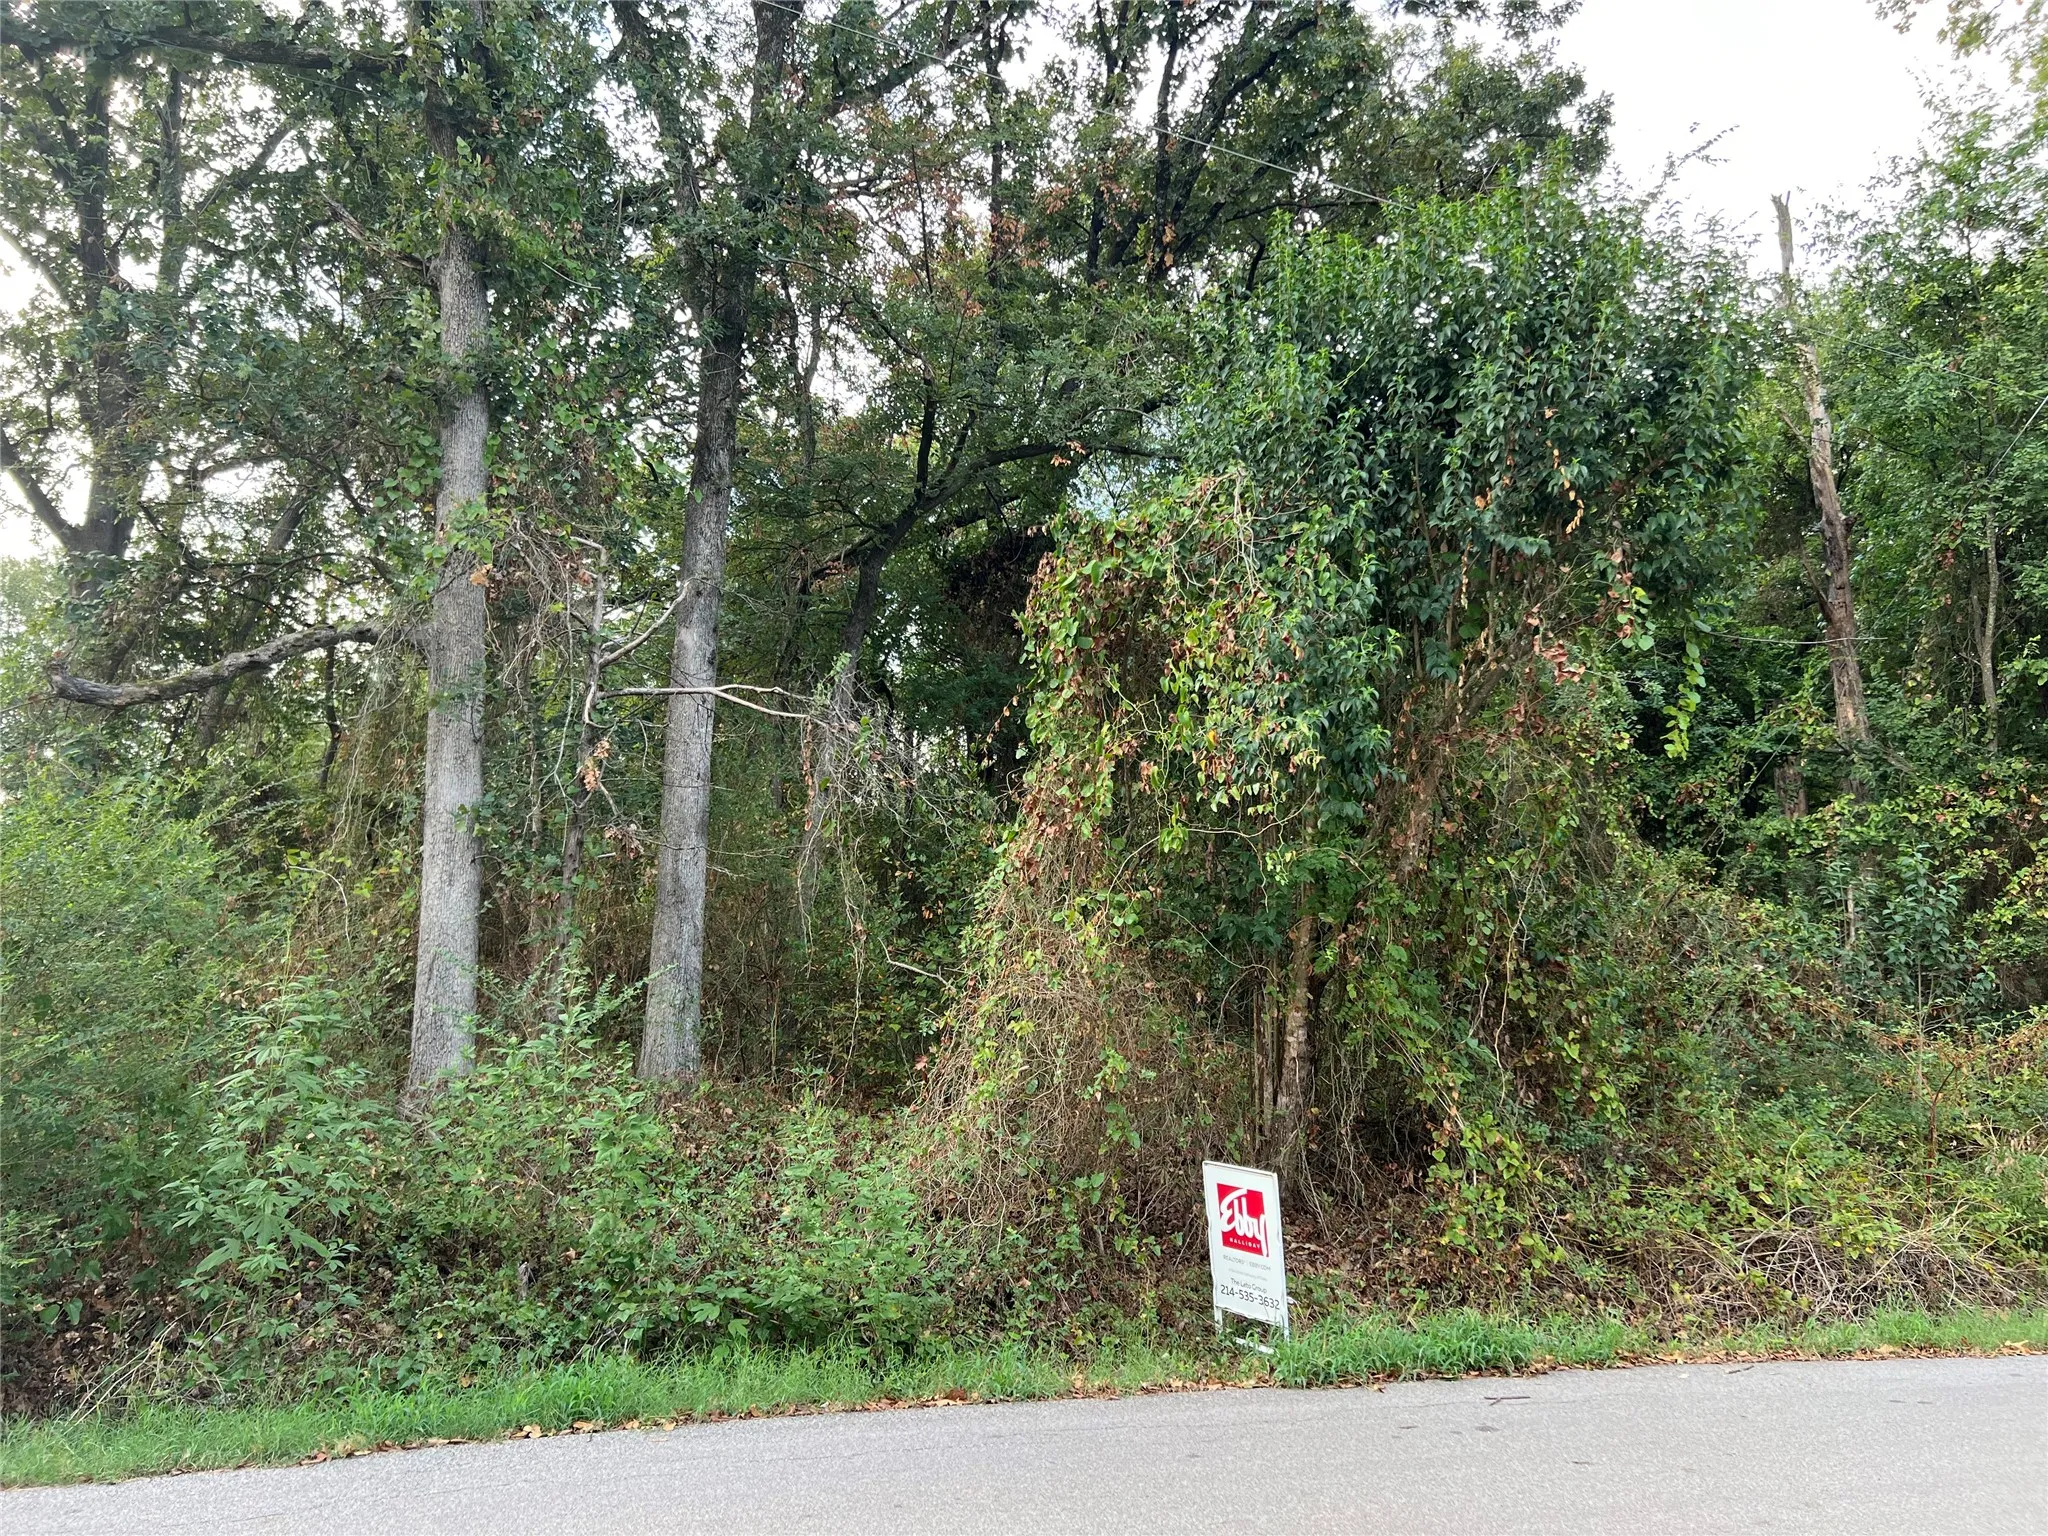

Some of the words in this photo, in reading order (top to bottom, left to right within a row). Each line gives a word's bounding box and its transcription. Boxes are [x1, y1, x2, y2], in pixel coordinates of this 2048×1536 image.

[1220, 1188, 1268, 1257] Ebby
[1229, 1237, 1260, 1248] HALLIDAY
[1230, 1277, 1239, 1286] The
[1252, 1284, 1267, 1294] Group
[1221, 1284, 1280, 1310] 214-535-3632
